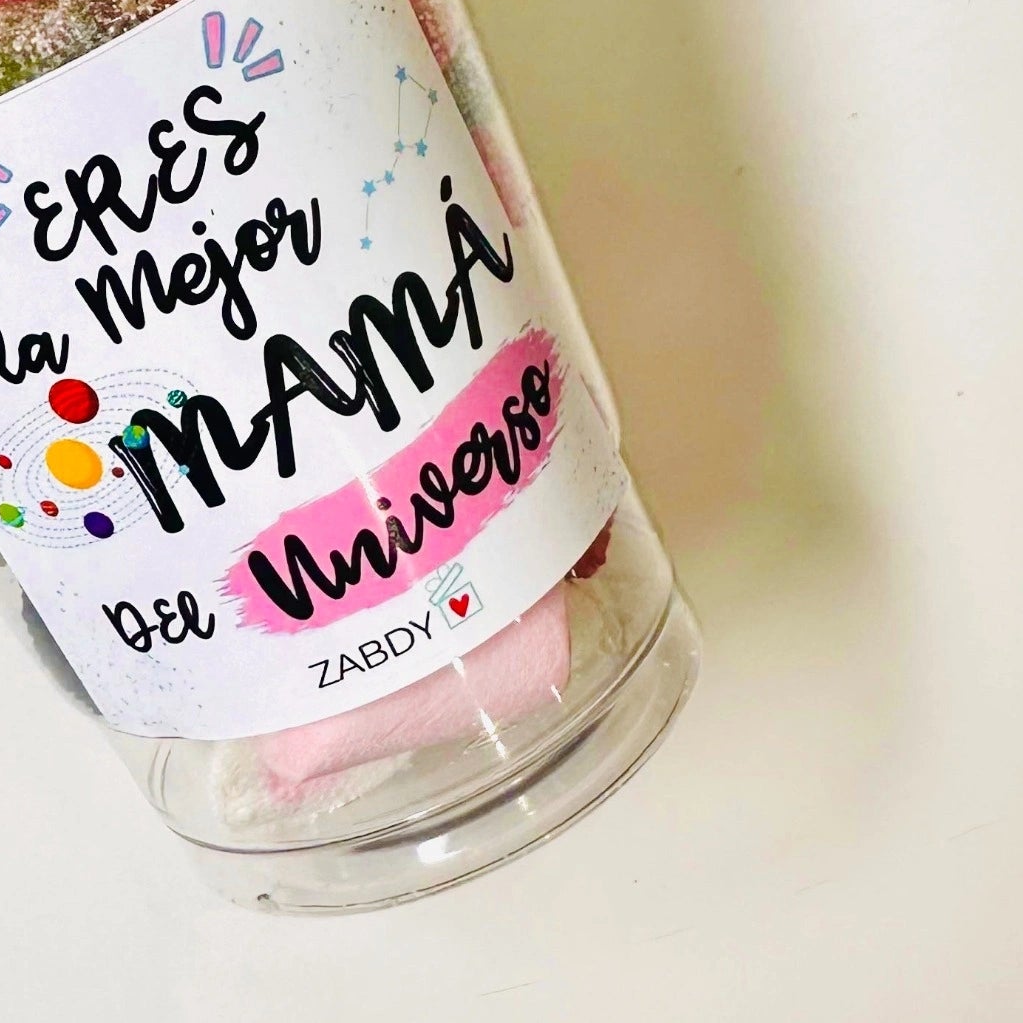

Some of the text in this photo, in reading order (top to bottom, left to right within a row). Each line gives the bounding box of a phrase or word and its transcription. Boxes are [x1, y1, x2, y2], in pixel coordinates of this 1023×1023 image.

[23, 85, 266, 262] ERES
[75, 197, 322, 344] Mejor
[109, 176, 514, 533] MAMÁ
[248, 358, 553, 620] Universo
[308, 611, 436, 689] ZABDY
